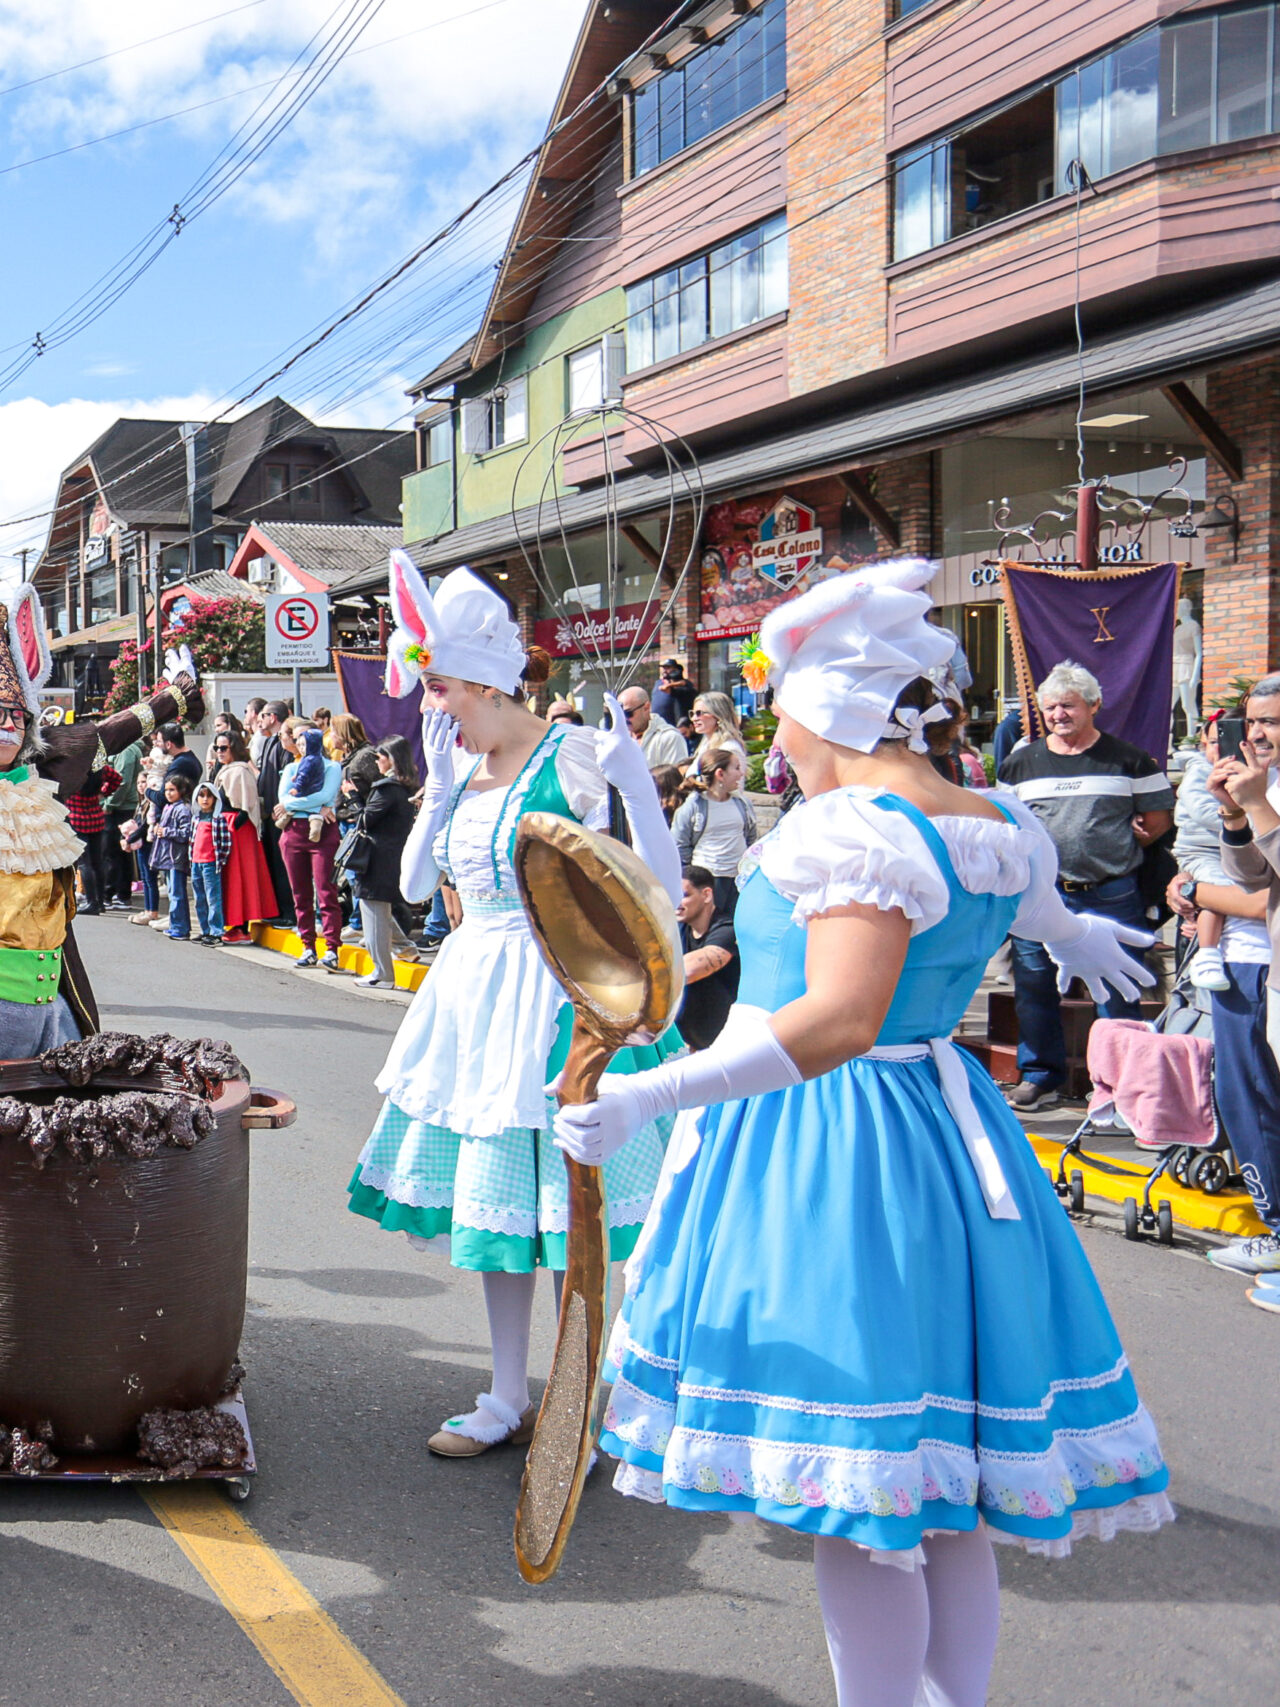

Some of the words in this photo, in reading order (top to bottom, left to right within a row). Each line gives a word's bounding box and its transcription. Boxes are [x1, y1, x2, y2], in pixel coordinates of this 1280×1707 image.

[753, 545, 776, 558] Casa
[777, 540, 820, 558] Colono
[574, 619, 605, 639] Dolce
[604, 614, 640, 635] Monte
[1090, 607, 1115, 643] X
